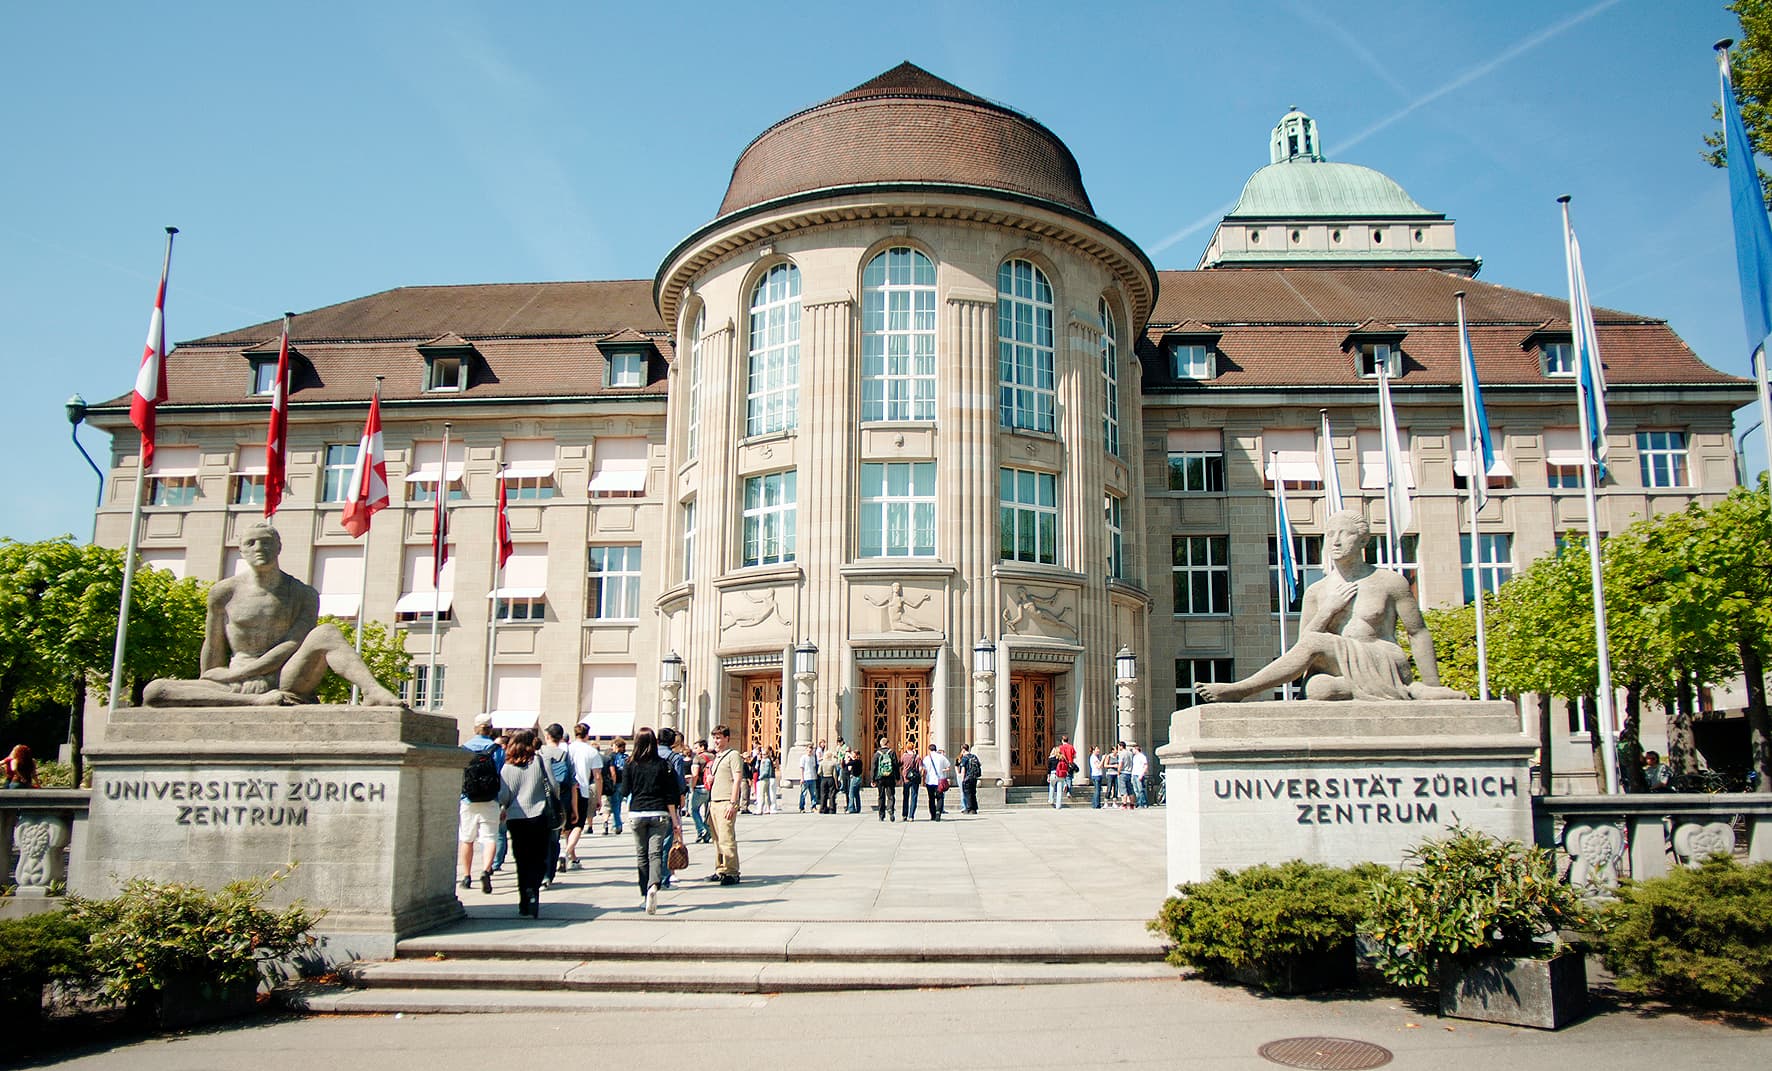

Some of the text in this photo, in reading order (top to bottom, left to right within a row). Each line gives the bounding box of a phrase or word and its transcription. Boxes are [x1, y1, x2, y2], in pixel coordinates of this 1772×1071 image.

[104, 778, 385, 801] UNIVERSITÄT ZÜRICH
[1214, 773, 1518, 800] UNIVERSITÄT ZÜRICH
[176, 805, 308, 826] ZENTRUM
[1297, 803, 1438, 824] ZENTRUM
